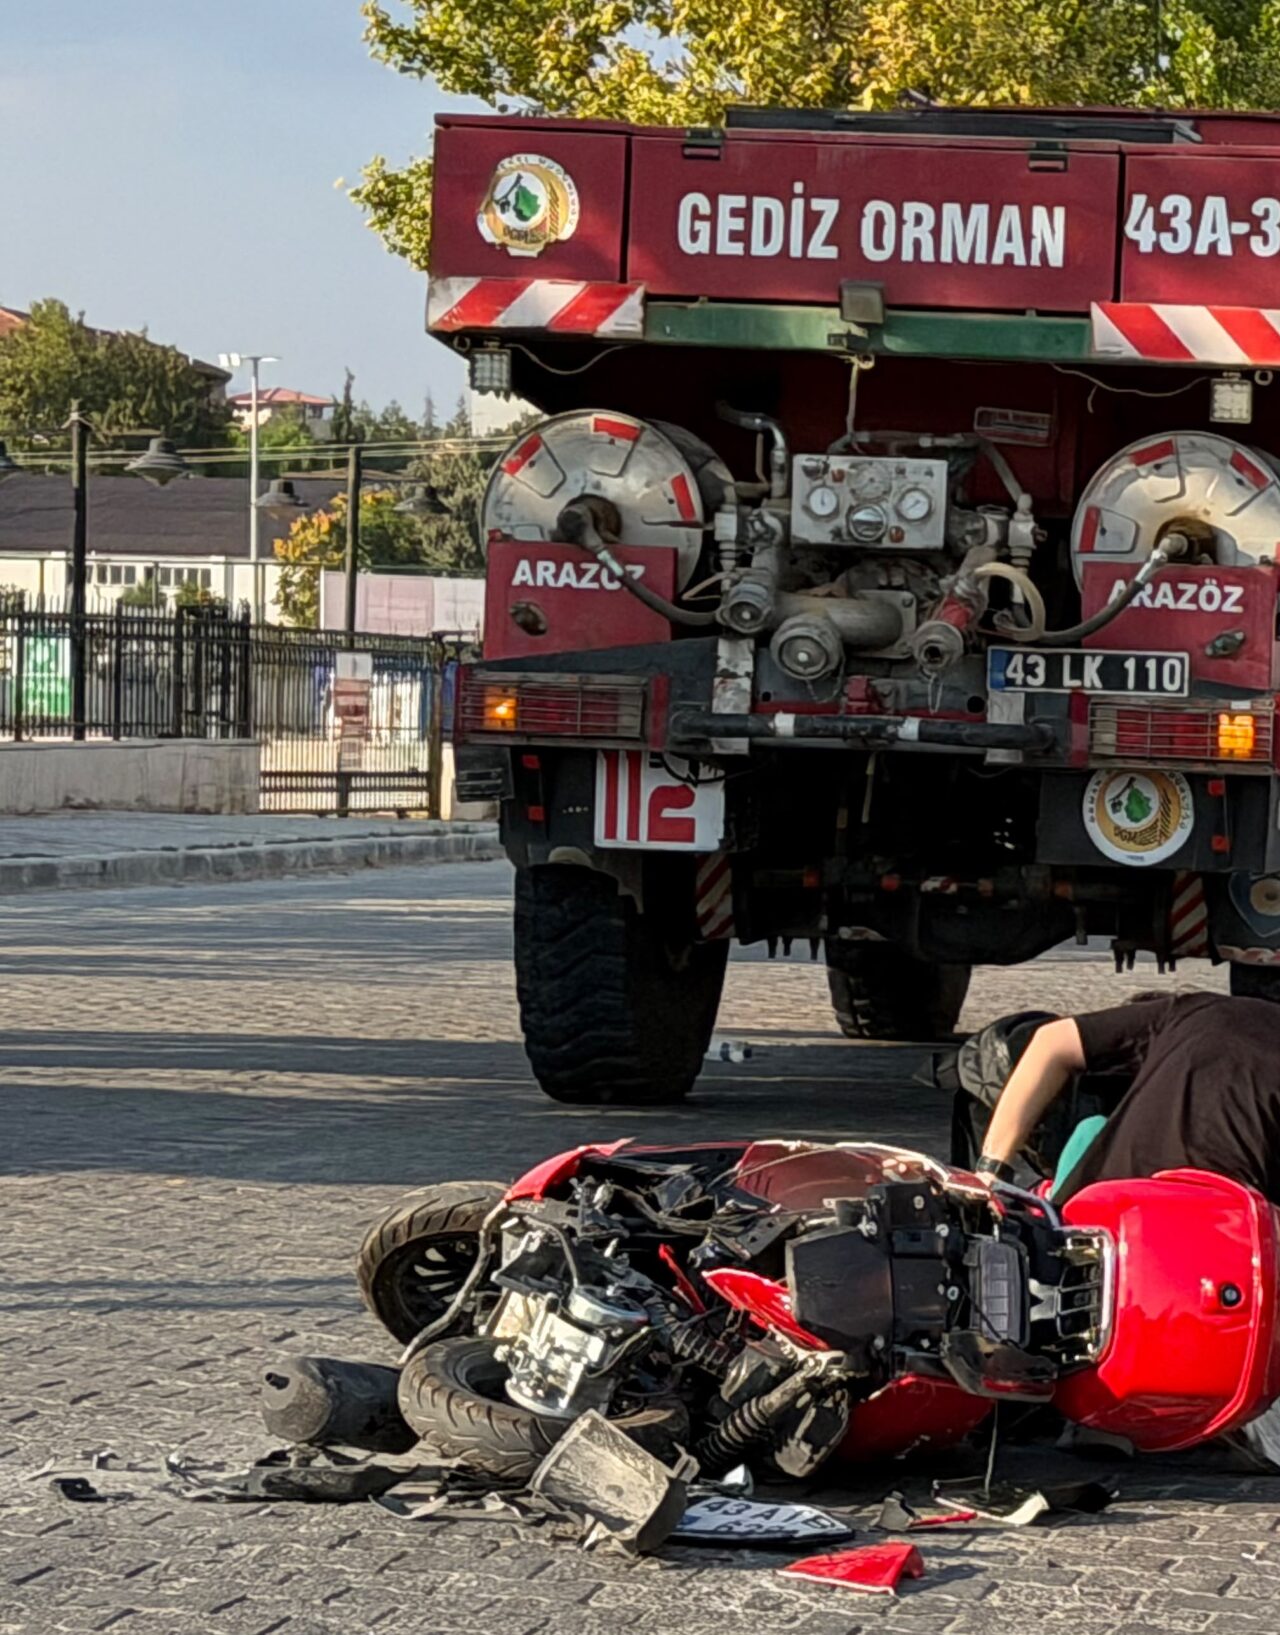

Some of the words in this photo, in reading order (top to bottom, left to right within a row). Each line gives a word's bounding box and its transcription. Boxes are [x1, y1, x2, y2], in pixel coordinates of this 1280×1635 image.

[677, 181, 840, 260] GEDİZ
[860, 201, 1065, 268] ORMAN
[1005, 653, 1046, 686] 43
[1062, 655, 1104, 688] LK
[1123, 657, 1182, 692] 110
[702, 1499, 751, 1516] 43
